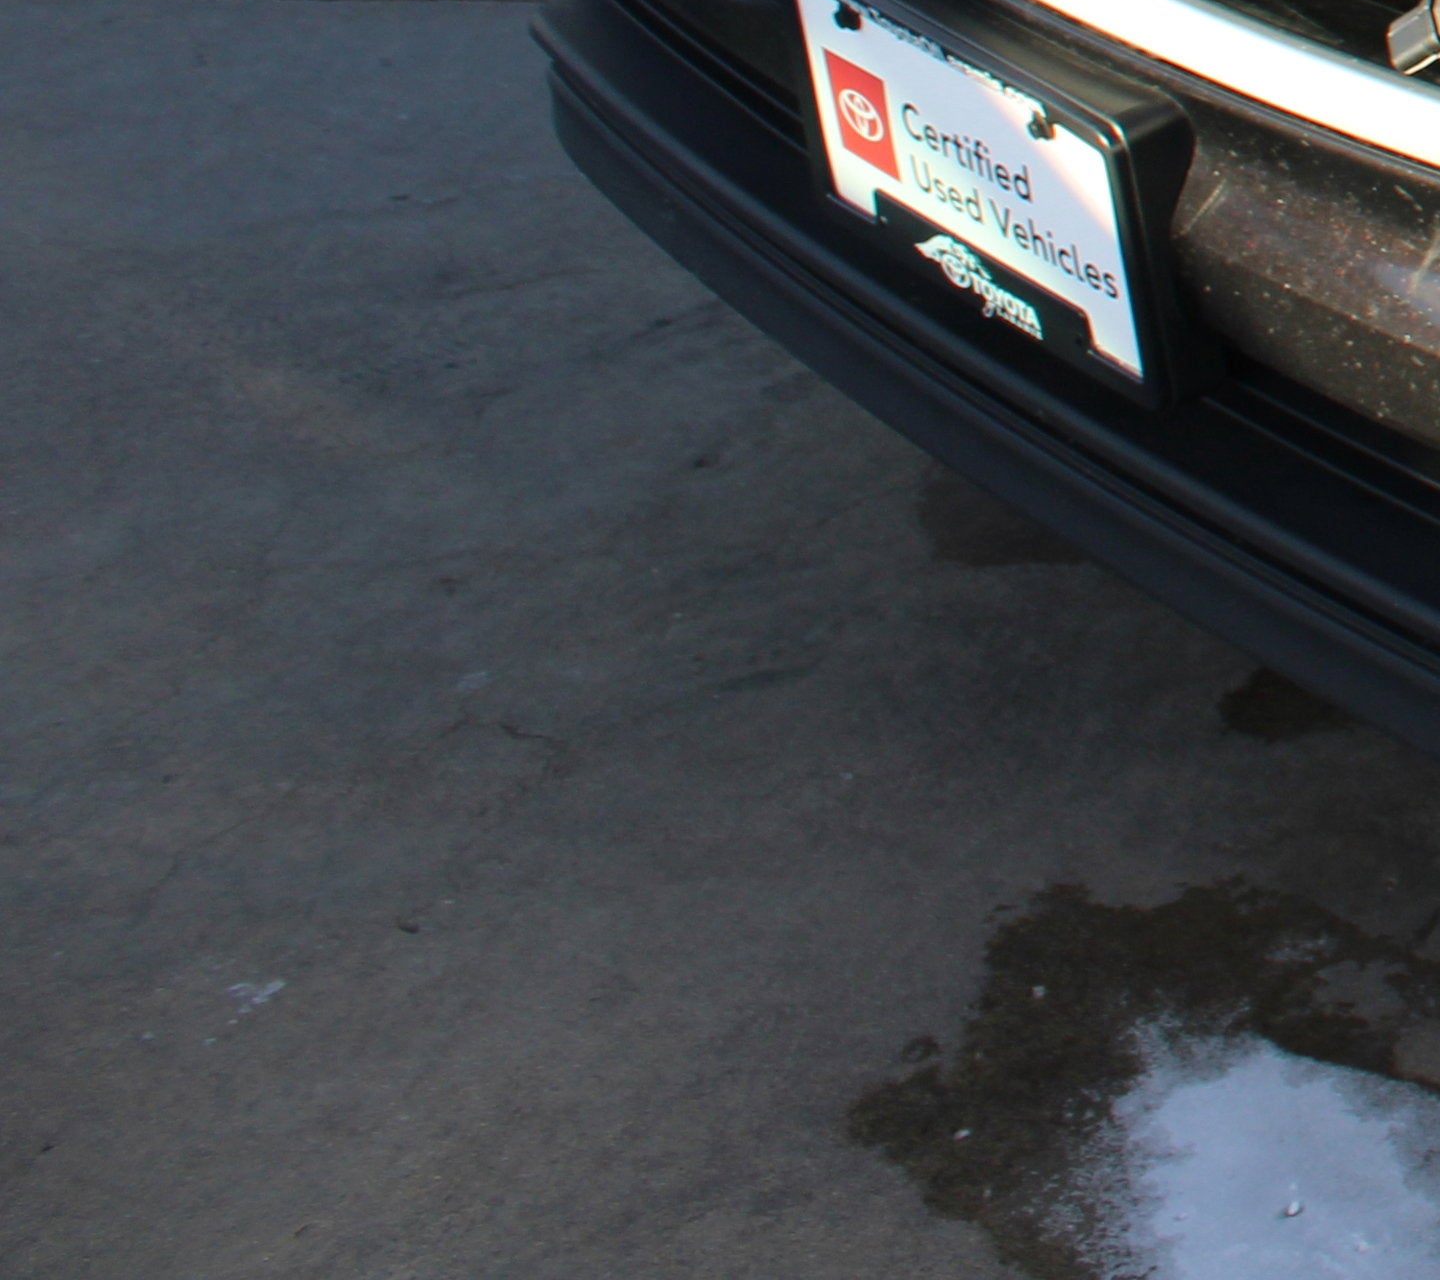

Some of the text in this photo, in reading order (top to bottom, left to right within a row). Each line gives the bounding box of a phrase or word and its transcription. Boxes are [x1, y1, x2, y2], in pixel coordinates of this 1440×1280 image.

[902, 103, 1033, 202] Certified
[910, 154, 1119, 300] Used Vehicles
